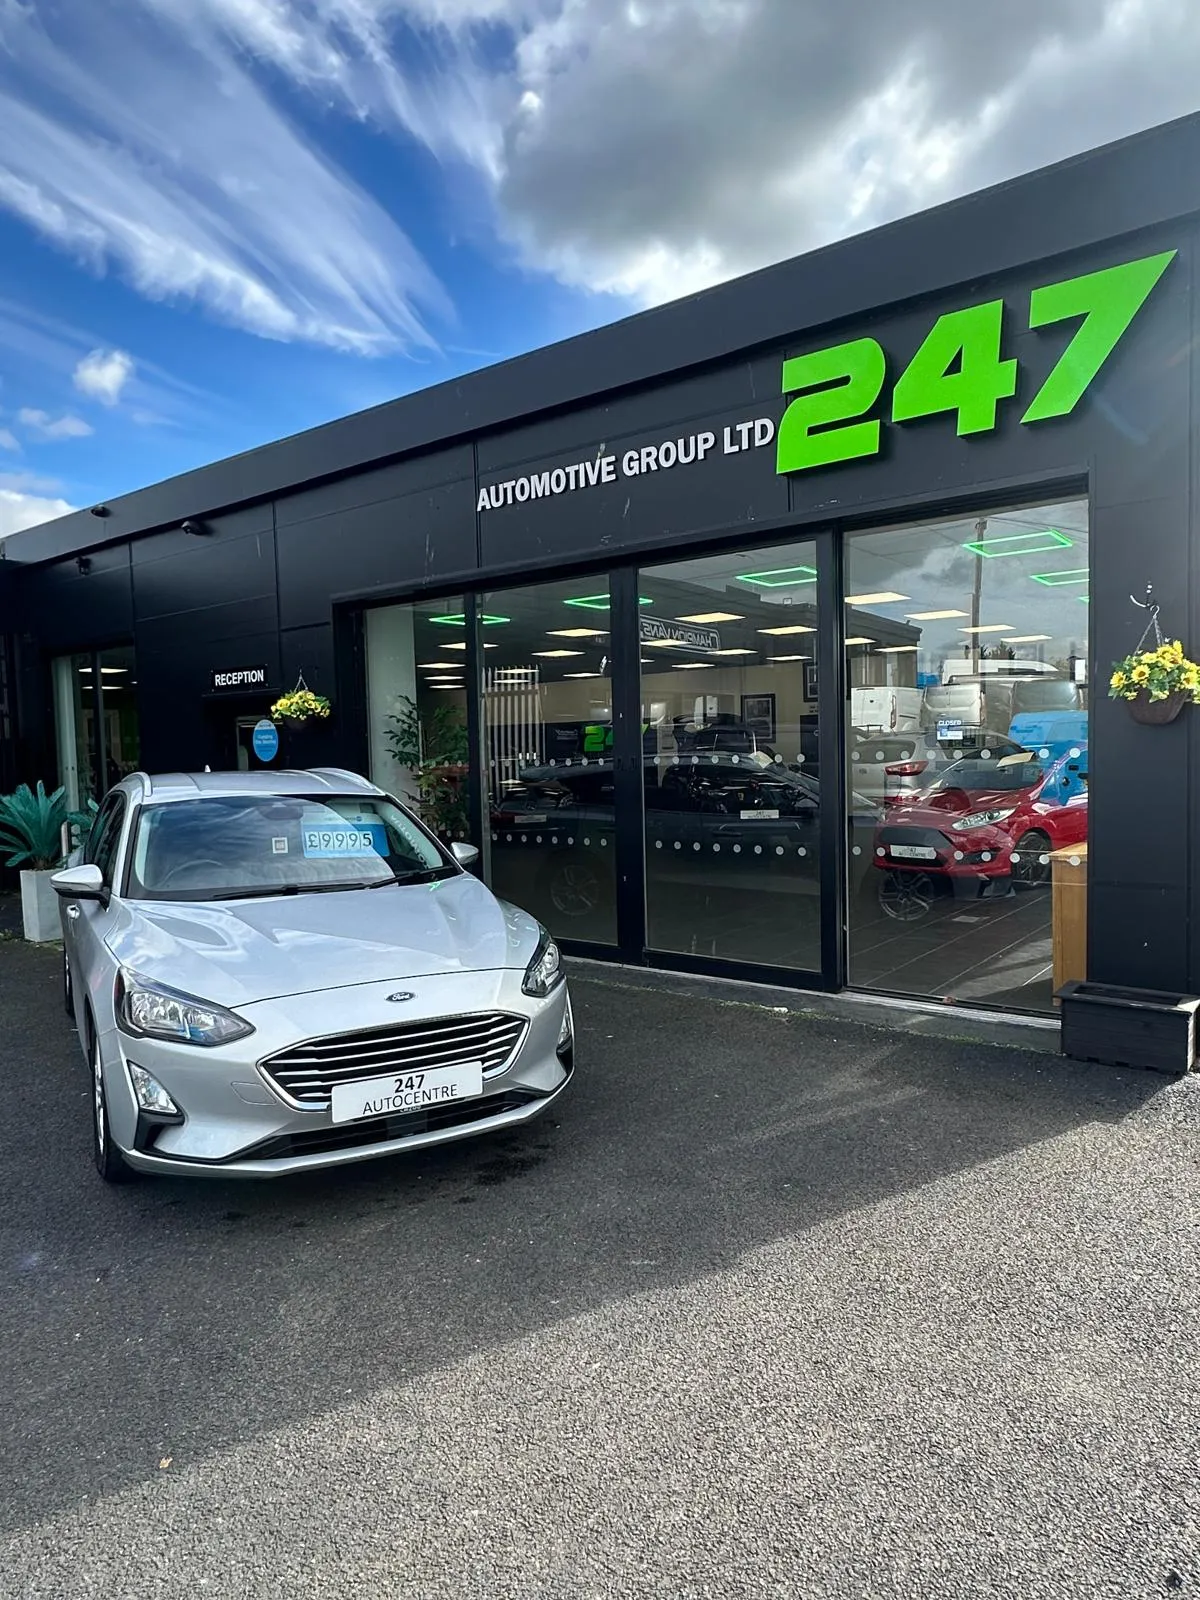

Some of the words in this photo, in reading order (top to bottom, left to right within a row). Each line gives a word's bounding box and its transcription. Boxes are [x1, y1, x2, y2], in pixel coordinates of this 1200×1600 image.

[776, 249, 1178, 475] 247
[476, 455, 617, 512] AUTOMOTIVE
[622, 431, 716, 477] GROUP
[723, 417, 776, 454] LTD
[214, 669, 264, 687] RECEPTION
[307, 832, 372, 849] £9995
[391, 992, 410, 1001] Ford
[394, 1074, 425, 1094] 247
[362, 1083, 458, 1115] AUTOCENTRE
